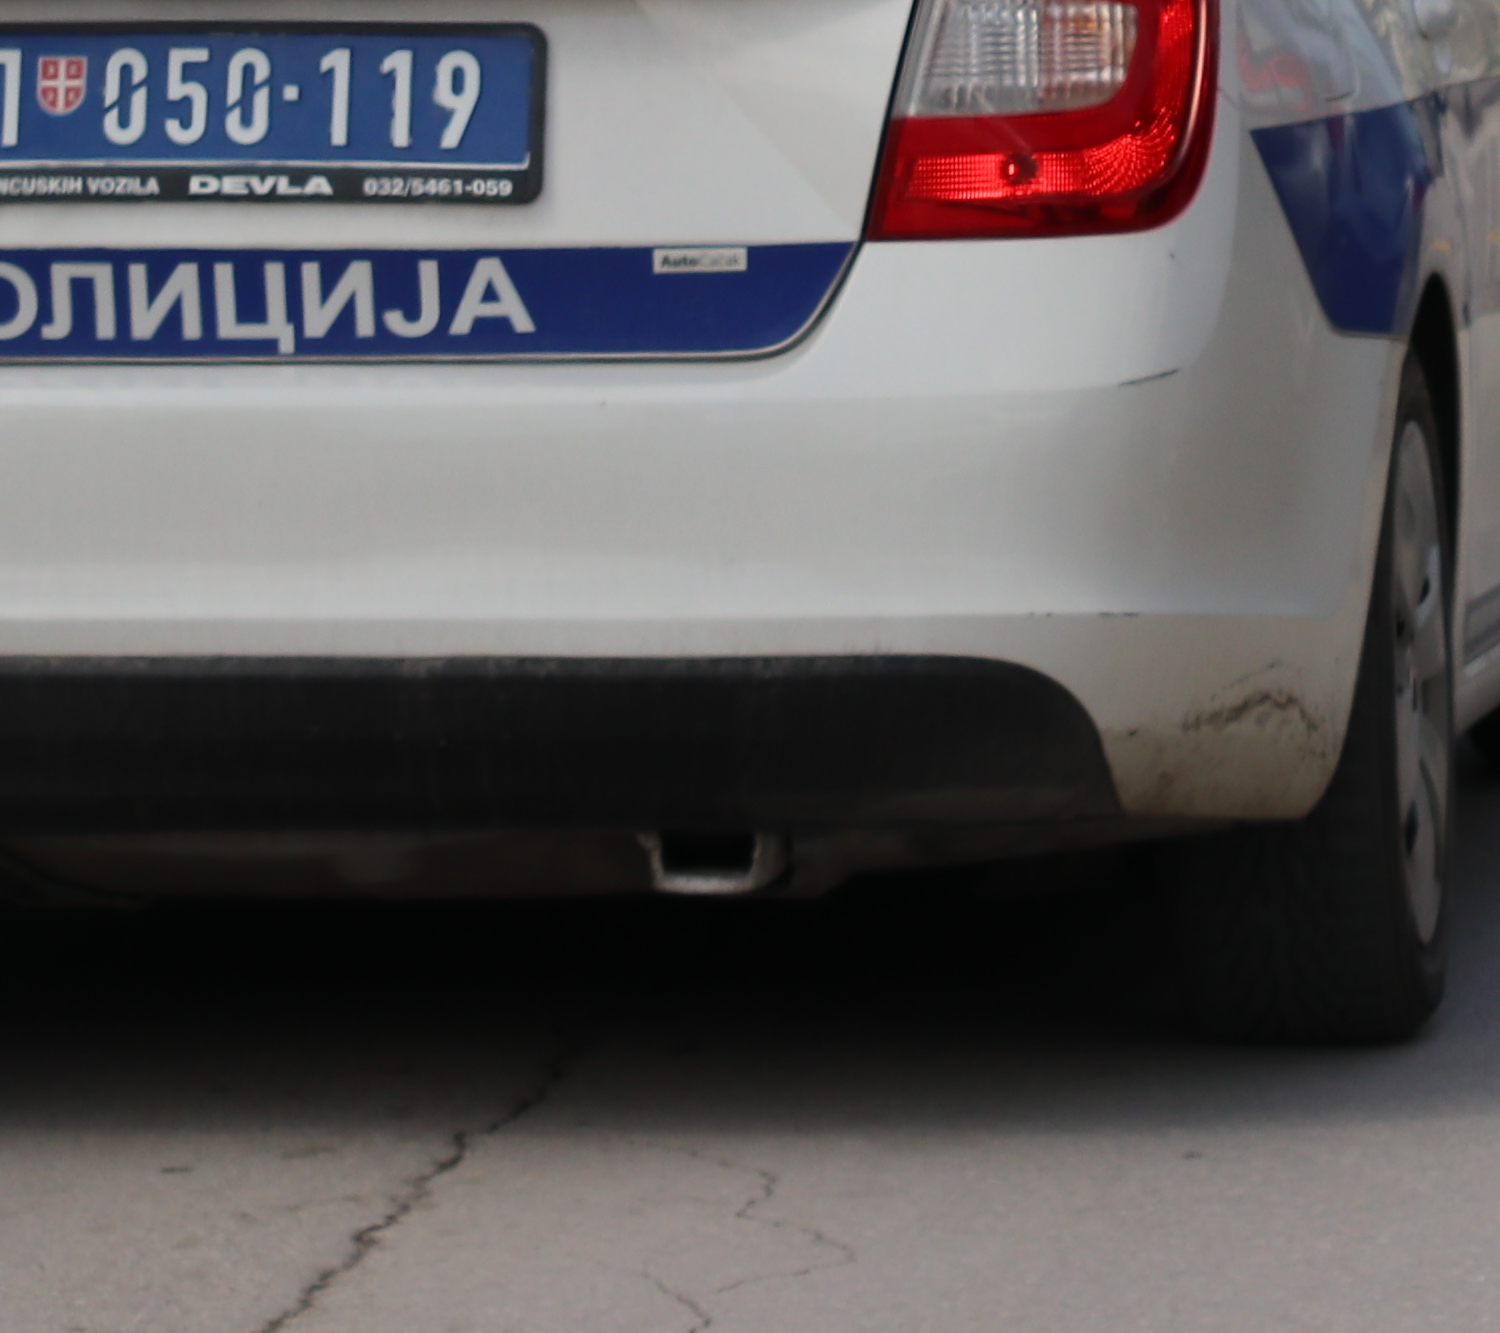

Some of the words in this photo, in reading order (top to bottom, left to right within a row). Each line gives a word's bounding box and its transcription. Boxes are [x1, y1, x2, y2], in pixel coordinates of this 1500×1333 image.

[86, 176, 160, 196] VOZILA
[188, 173, 334, 197] DEVLA
[362, 176, 514, 198] 032/5461-059
